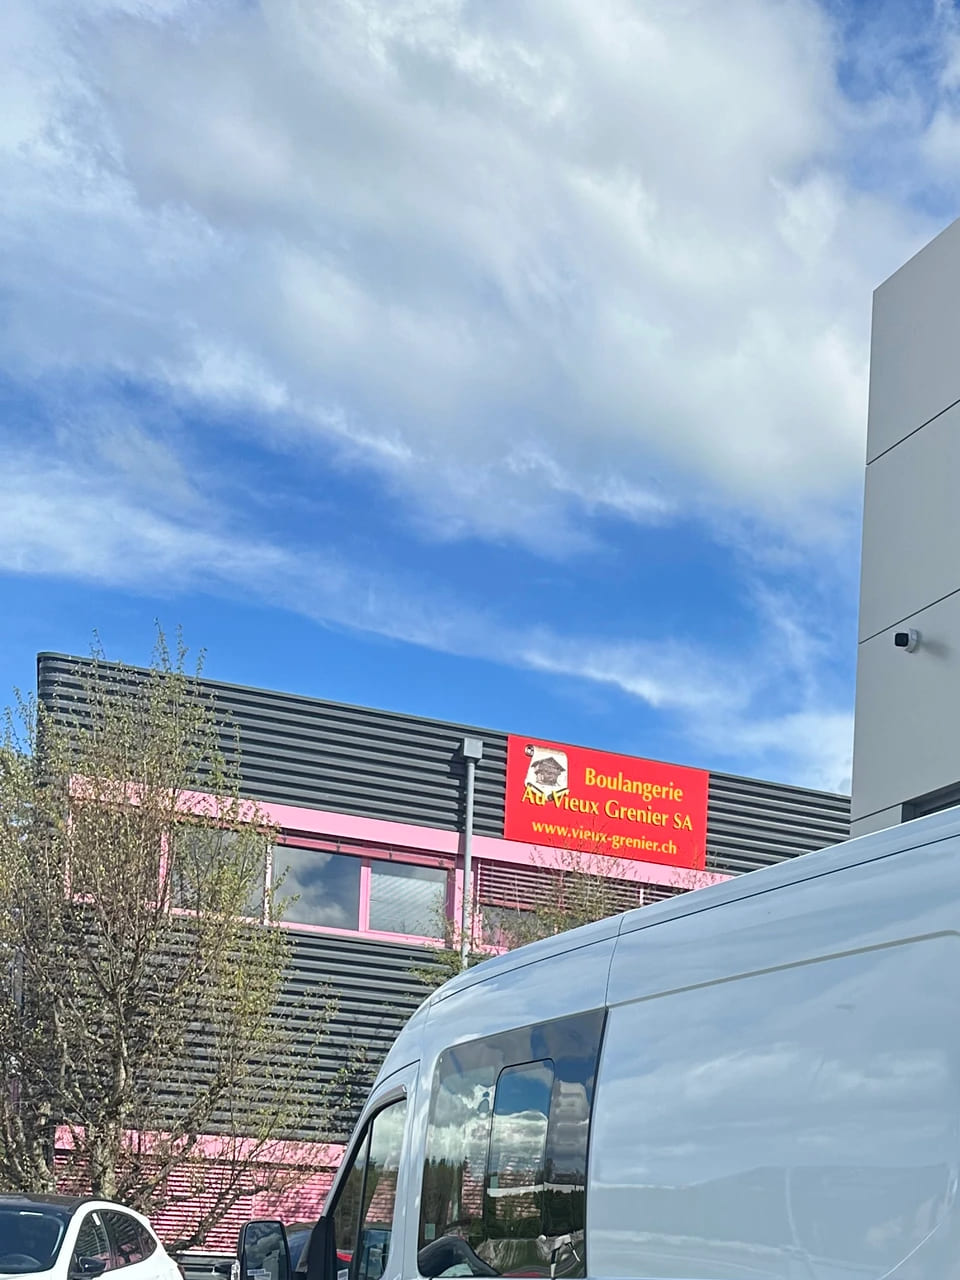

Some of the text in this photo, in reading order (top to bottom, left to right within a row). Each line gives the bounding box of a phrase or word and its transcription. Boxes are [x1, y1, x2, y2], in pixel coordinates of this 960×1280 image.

[585, 767, 684, 802] Boulangerie
[522, 785, 693, 831] Au Vieux Grenier SA
[532, 820, 677, 855] www.vieux-grenier.ch
